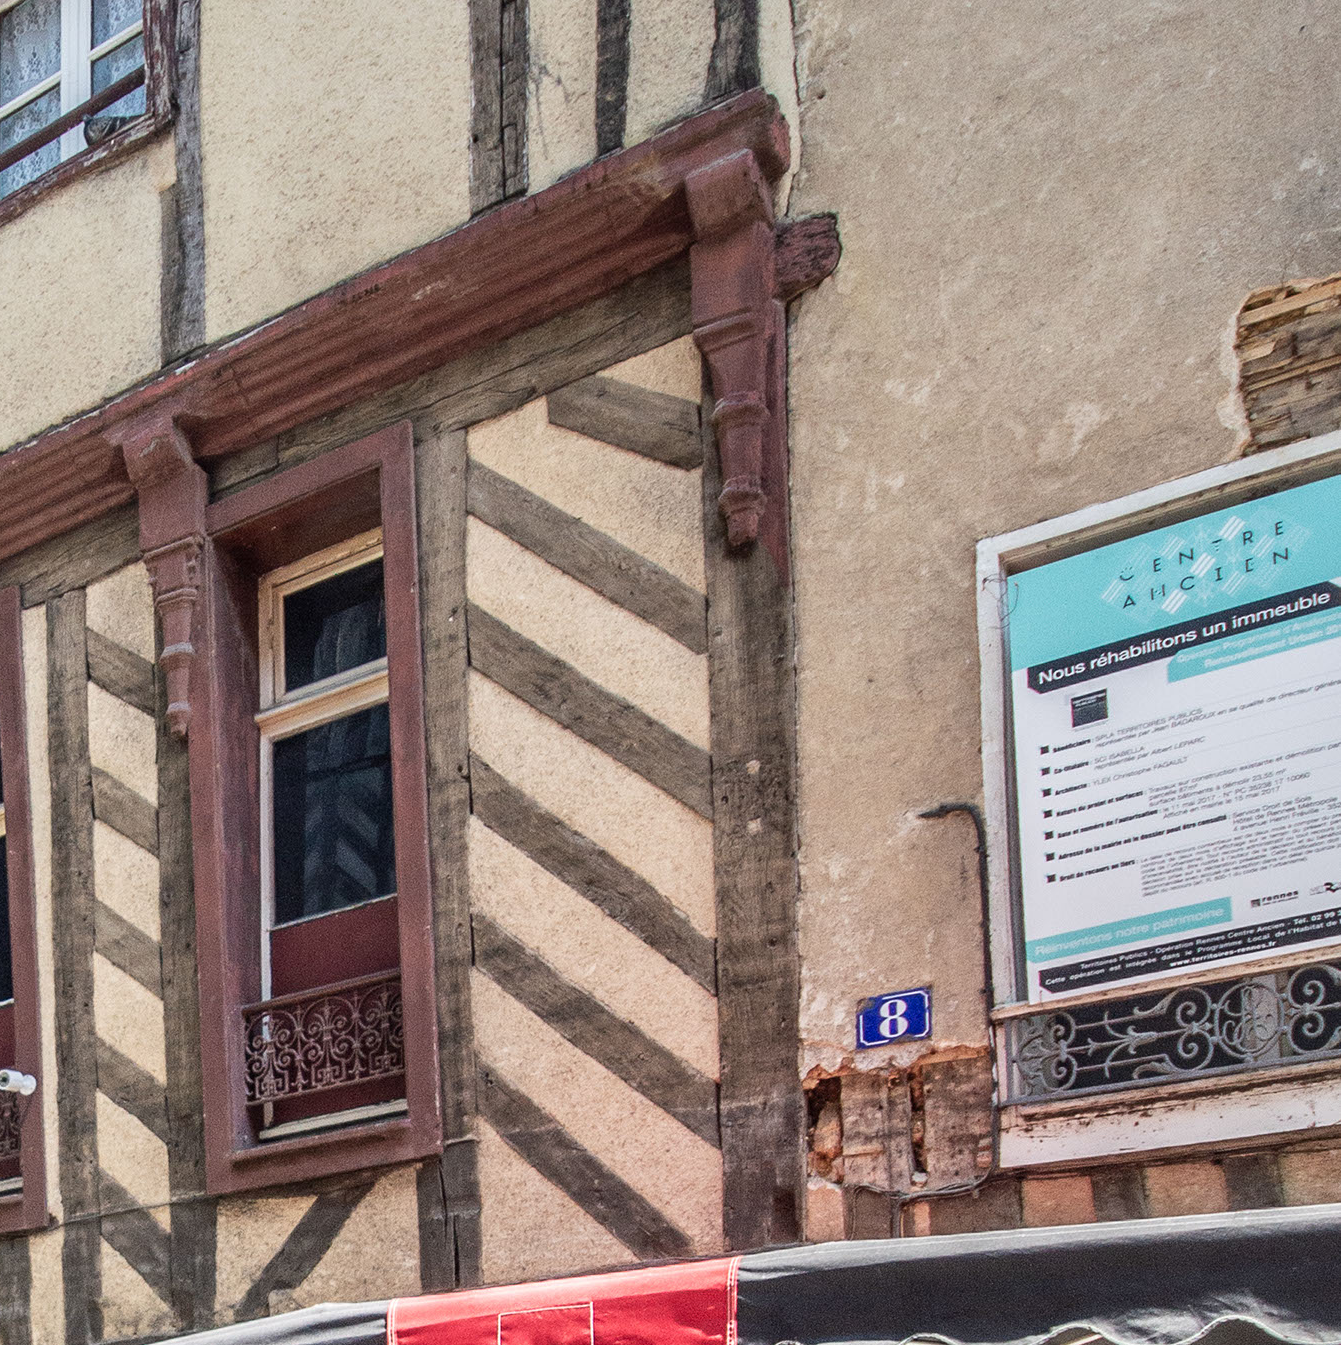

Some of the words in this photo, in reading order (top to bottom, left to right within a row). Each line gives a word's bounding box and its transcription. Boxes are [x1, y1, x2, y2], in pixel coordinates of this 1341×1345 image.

[1118, 519, 1285, 582] CENTRE
[1038, 659, 1086, 685] Nous
[1089, 626, 1197, 670] réhabilitons
[1202, 620, 1227, 637] un
[1231, 588, 1331, 629] immeuble
[1150, 723, 1169, 733] Jean
[1265, 694, 1276, 703] de
[1277, 684, 1313, 700] directeur
[1116, 717, 1166, 736] TERRITOIRES
[1190, 766, 1237, 783] construction
[1284, 744, 1325, 760] démolition
[1232, 806, 1261, 818] Service
[1266, 804, 1296, 817] Rennes
[1261, 889, 1298, 903] rennes
[1152, 906, 1224, 932] patrimoine
[1195, 933, 1225, 946] Rennes
[1227, 927, 1255, 939] Centre
[1256, 921, 1285, 933] Ancien
[879, 999, 909, 1038] 8
